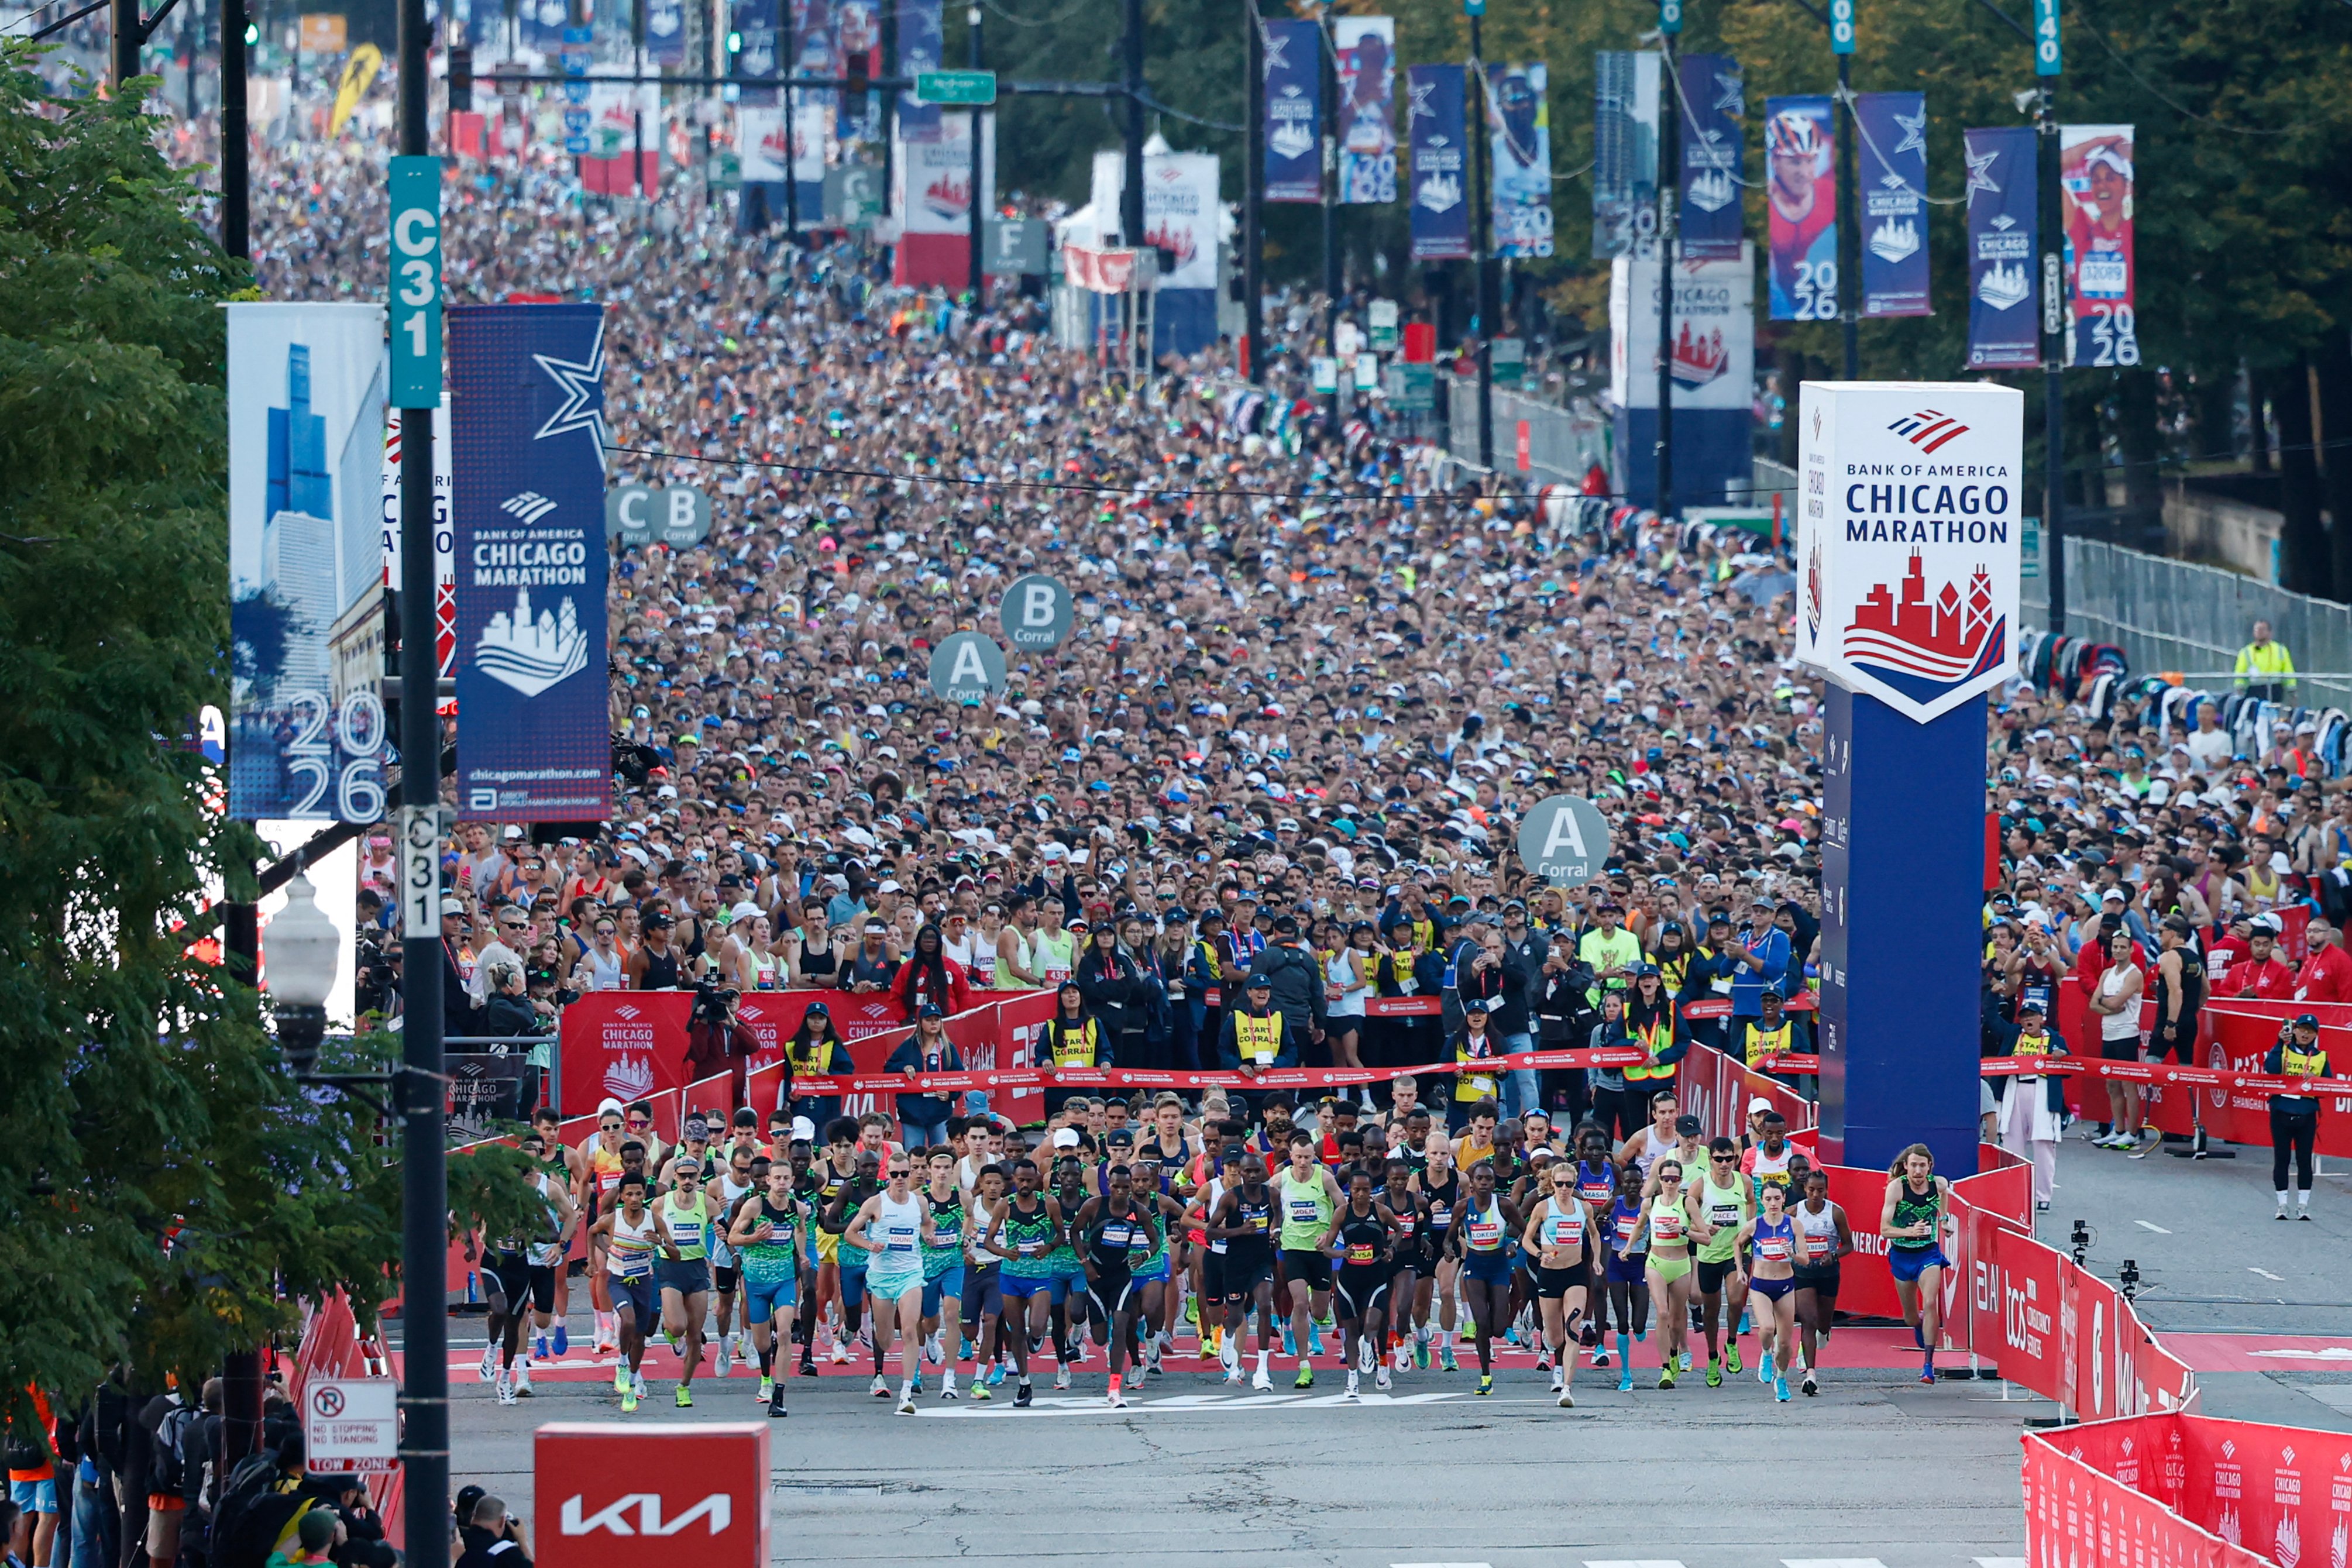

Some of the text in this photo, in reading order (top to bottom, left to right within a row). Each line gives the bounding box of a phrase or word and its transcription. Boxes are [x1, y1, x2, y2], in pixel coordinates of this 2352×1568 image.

[1359, 153, 1397, 176] 20
[1359, 177, 1397, 202] 26
[1616, 206, 1657, 234] 20
[1000, 223, 1024, 256] F
[1978, 238, 2028, 250] CHICAGO
[394, 208, 436, 357] C31
[1794, 262, 1837, 291] 20
[1794, 292, 1837, 321] 26
[2092, 303, 2134, 335] 20
[2093, 336, 2139, 367] 26
[1848, 465, 2007, 477] BANK OF AMERICA
[1846, 483, 2008, 515] CHICAGO
[618, 490, 648, 529] C
[669, 489, 696, 527] B
[474, 528, 584, 541] BANK OF AMERICA
[622, 531, 650, 543] orral
[662, 529, 697, 541] Corral
[1846, 520, 2007, 544] MARATHON
[474, 542, 586, 566] CHICAGO
[474, 566, 586, 586] MARATHON
[1024, 584, 1056, 627] B
[1014, 628, 1055, 643] Corral
[950, 641, 989, 684] A
[948, 687, 989, 700] Corra
[291, 690, 386, 758] 20
[469, 768, 601, 783] chicagomarathon.com
[288, 759, 387, 824] 26
[1542, 807, 1588, 858] A
[1538, 862, 1588, 878] Corral
[1050, 971, 1066, 980] 436
[603, 1030, 653, 1040] CHICAGO
[603, 1041, 653, 1050] MARATHON
[2286, 1062, 2315, 1071] STAT
[448, 1084, 497, 1095] CHICAGO
[448, 1094, 497, 1103] MARATHON
[2232, 1096, 2264, 1111] SHANGHAI
[1763, 1174, 1787, 1182] PACER
[1584, 1191, 1608, 1199] MASAI
[1292, 1207, 1315, 1215] MOEN
[771, 1231, 789, 1239] RUPP
[889, 1235, 913, 1243] YOUNG
[1807, 1242, 1827, 1250] EBEDE
[1852, 1231, 1891, 1256] MERICA
[2026, 1277, 2037, 1301] TATA
[2027, 1306, 2051, 1335] CONSULTANCY
[2027, 1333, 2042, 1360] SERVICES
[313, 1424, 378, 1433] NO STOPPING
[313, 1435, 378, 1444] NO STANDING
[315, 1458, 392, 1471] TOW ZONE
[2215, 1470, 2241, 1487] CHICAGO
[2275, 1477, 2301, 1494] CHICAGO
[2216, 1486, 2241, 1499] MARATHON
[2275, 1492, 2301, 1506] MARATHON
[2332, 1483, 2351, 1500] CHICAGO
[2332, 1499, 2351, 1512] MARATHON
[561, 1493, 731, 1536] KIA
